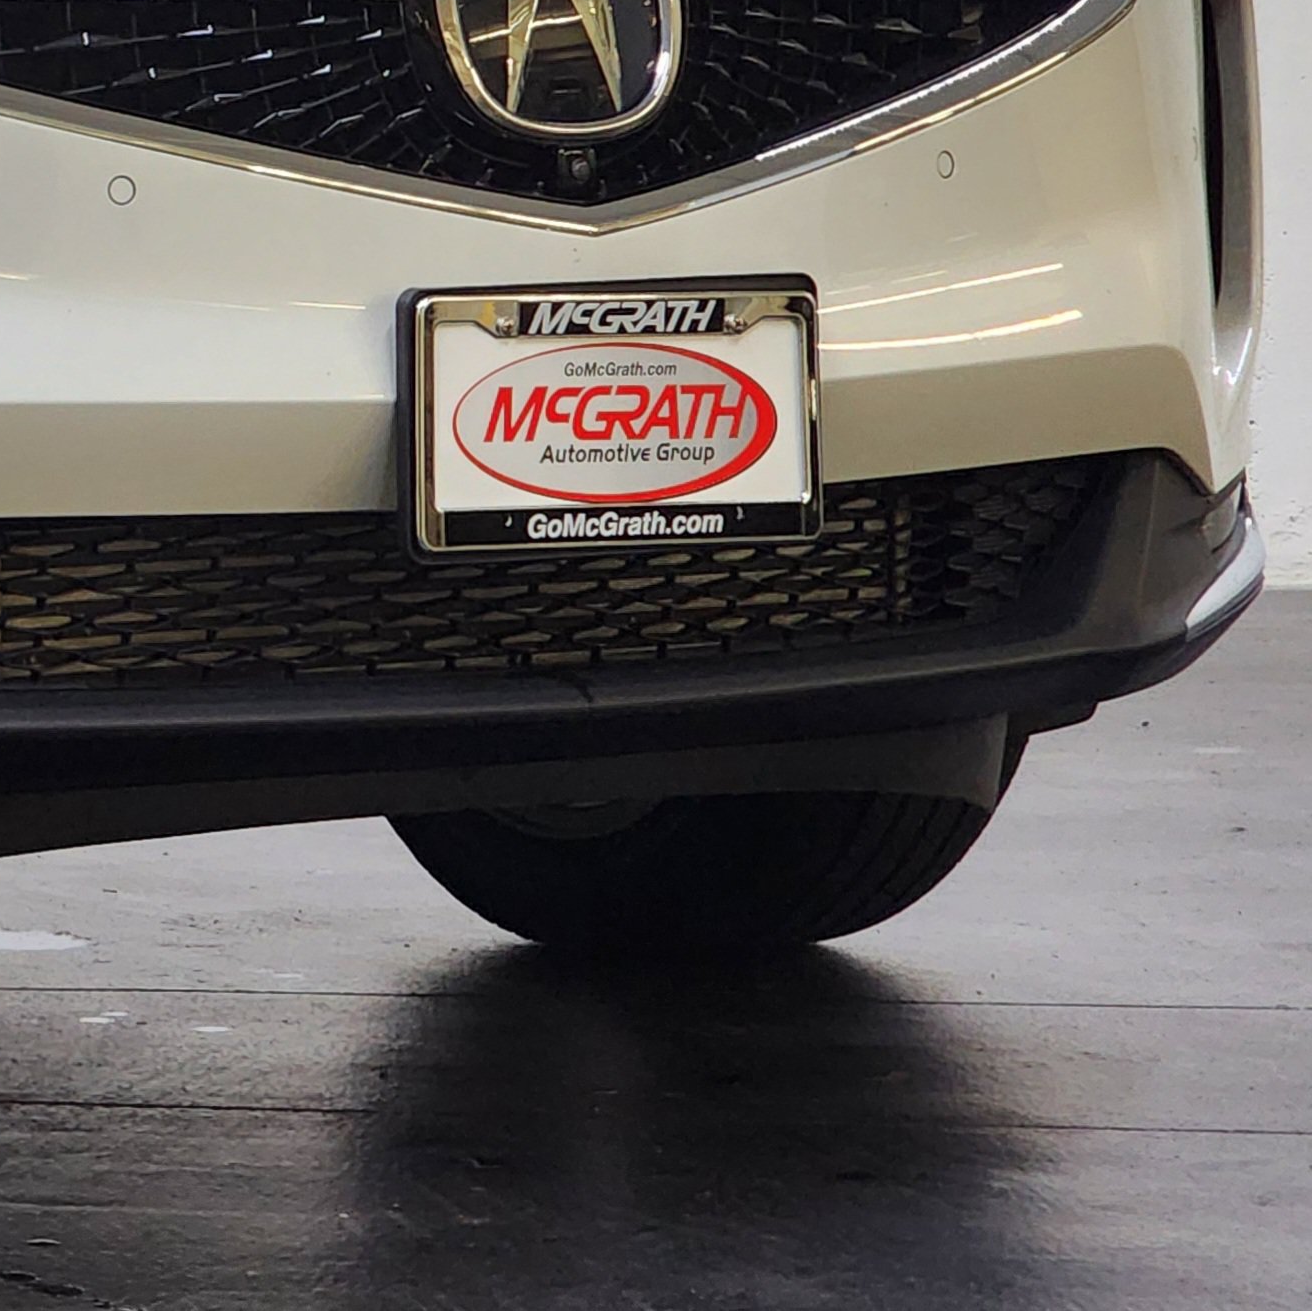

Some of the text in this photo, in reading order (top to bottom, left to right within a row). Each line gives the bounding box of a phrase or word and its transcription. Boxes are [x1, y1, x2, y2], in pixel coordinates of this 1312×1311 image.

[563, 361, 678, 378] GoMcGrath.com
[540, 443, 715, 465] Automotive Group
[527, 511, 724, 539] GoMcGrath.com
